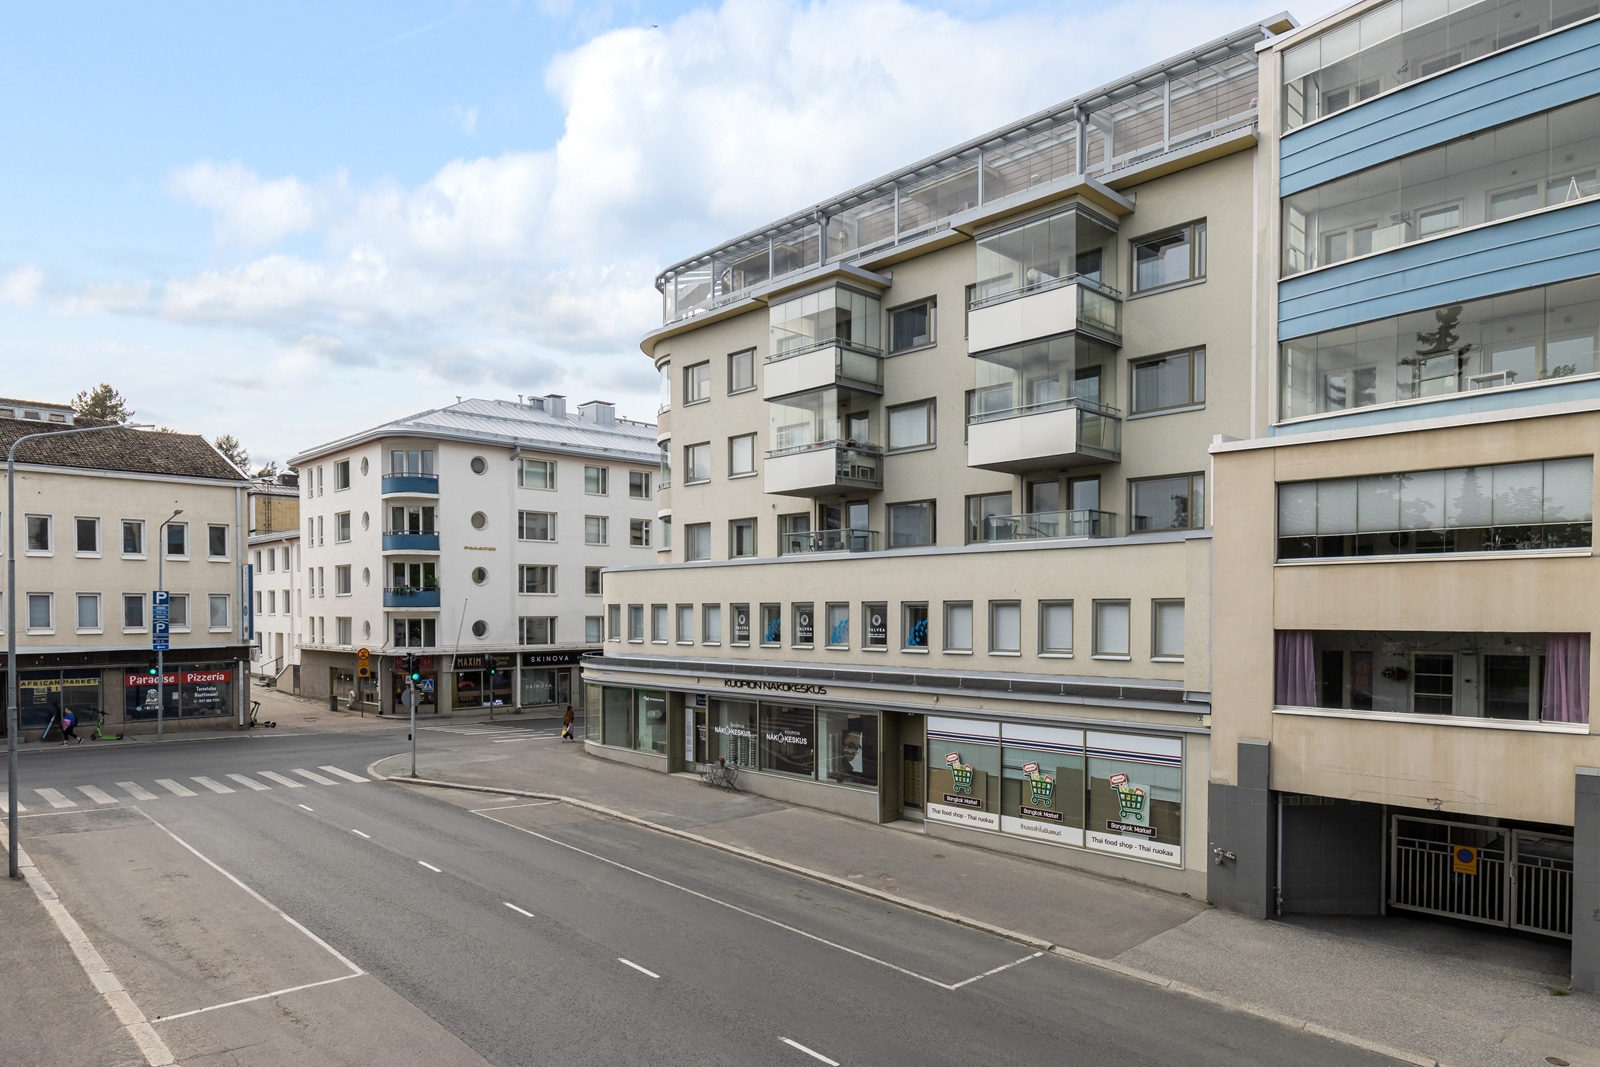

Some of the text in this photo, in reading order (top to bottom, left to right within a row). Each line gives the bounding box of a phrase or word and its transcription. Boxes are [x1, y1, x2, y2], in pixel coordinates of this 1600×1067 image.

[156, 592, 167, 604] P
[156, 623, 165, 633] P
[457, 656, 482, 667] MAXIM
[530, 655, 569, 663] SKINOVA
[187, 672, 225, 682] Pizzeria
[724, 680, 762, 690] KUOPION
[946, 795, 964, 803] Bangkok
[1023, 808, 1059, 819] Bangkok Market
[1110, 822, 1152, 835] Bangkok Market
[1119, 841, 1133, 849] shop
